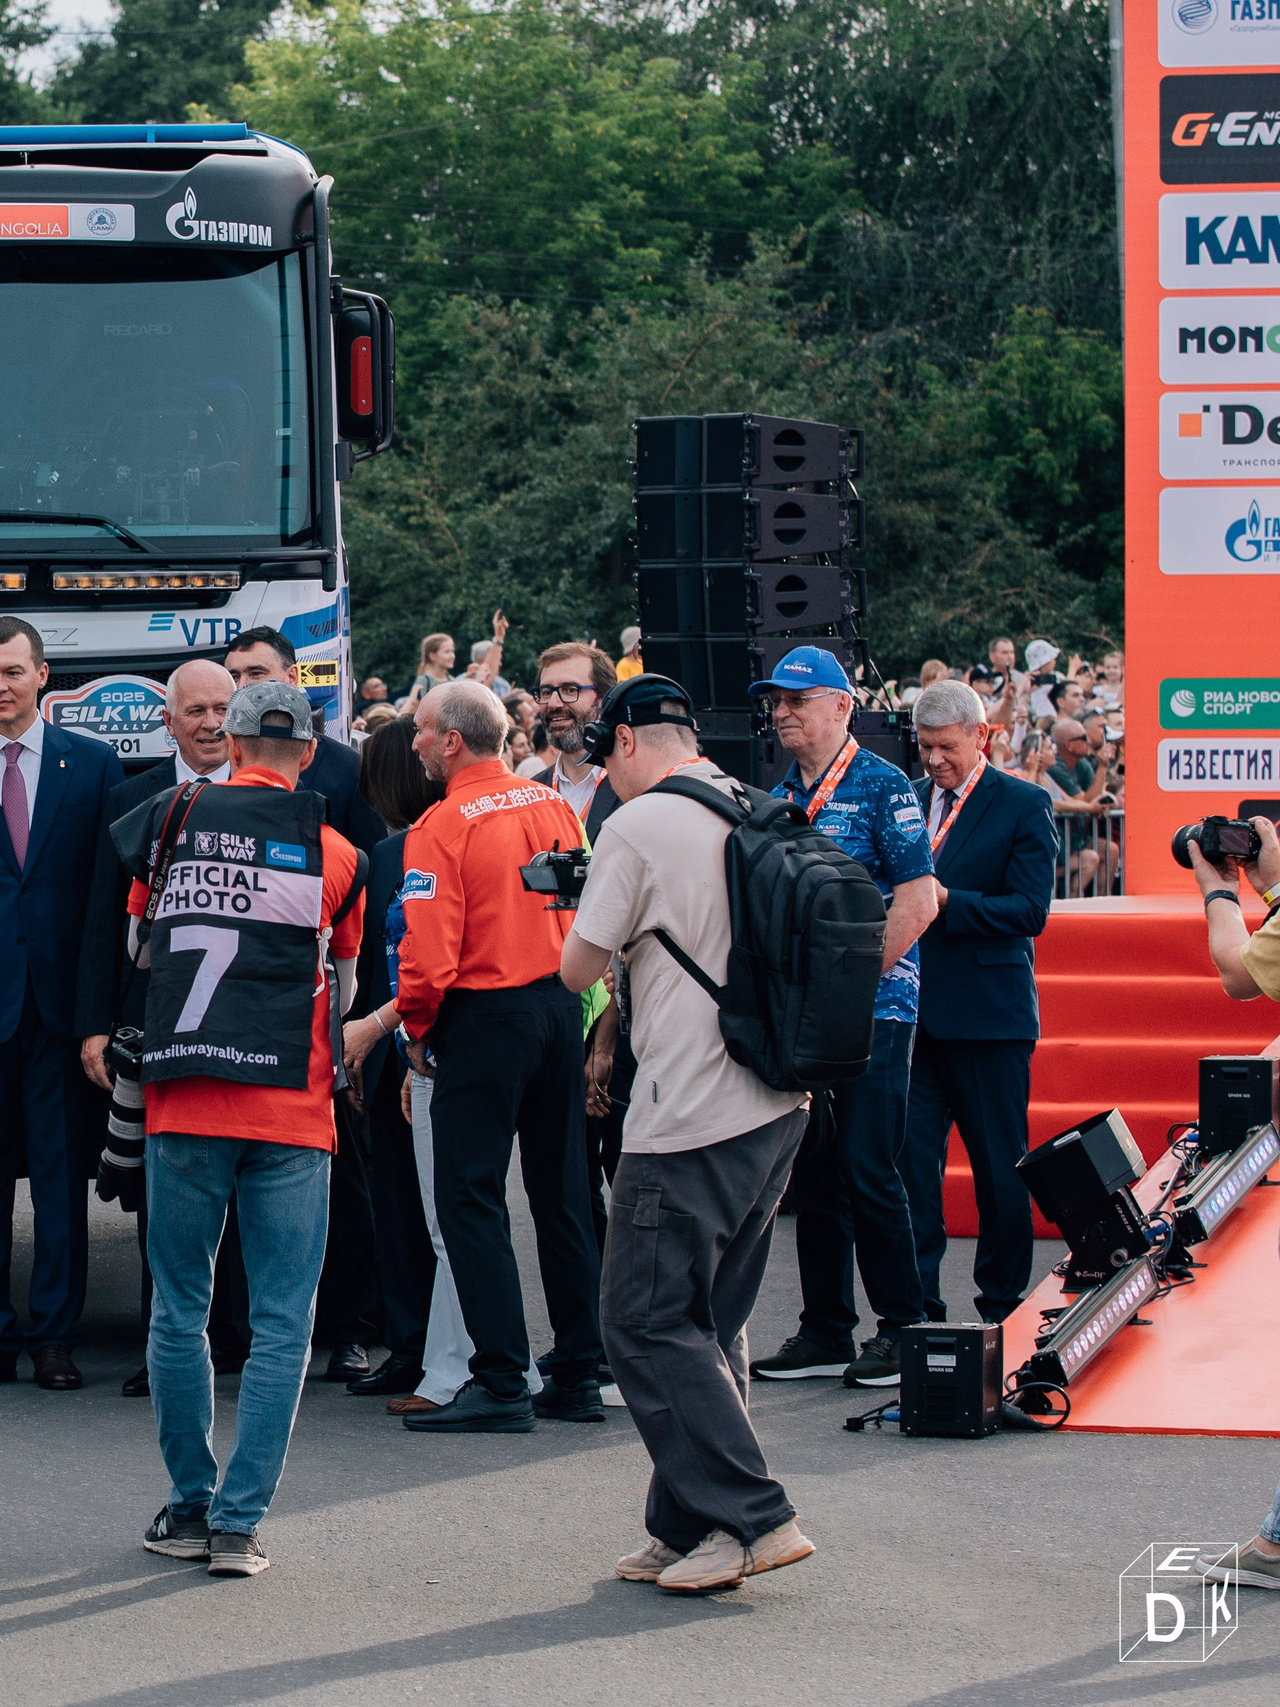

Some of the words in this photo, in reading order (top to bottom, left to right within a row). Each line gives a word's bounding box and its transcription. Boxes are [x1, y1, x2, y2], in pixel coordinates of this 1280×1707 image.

[199, 219, 272, 247] ГАЗПРОМ
[103, 323, 173, 337] RECARO
[179, 617, 241, 646] VTB
[783, 664, 813, 674] KAMAZ
[100, 691, 145, 703] 2025
[1203, 691, 1235, 703] РИА
[60, 704, 126, 723] SILK
[129, 704, 166, 721] WA
[1203, 703, 1254, 715] СПОРТ
[98, 723, 150, 732] RALLY
[109, 738, 141, 753] 301
[1168, 749, 1272, 780] ИЗВЕСТИЯ
[220, 832, 256, 850] SILK
[221, 846, 256, 862] WAY
[166, 865, 268, 893] FFICIAL
[146, 891, 159, 920] EOS
[163, 889, 252, 914] PHOTO
[170, 925, 239, 1033] 7
